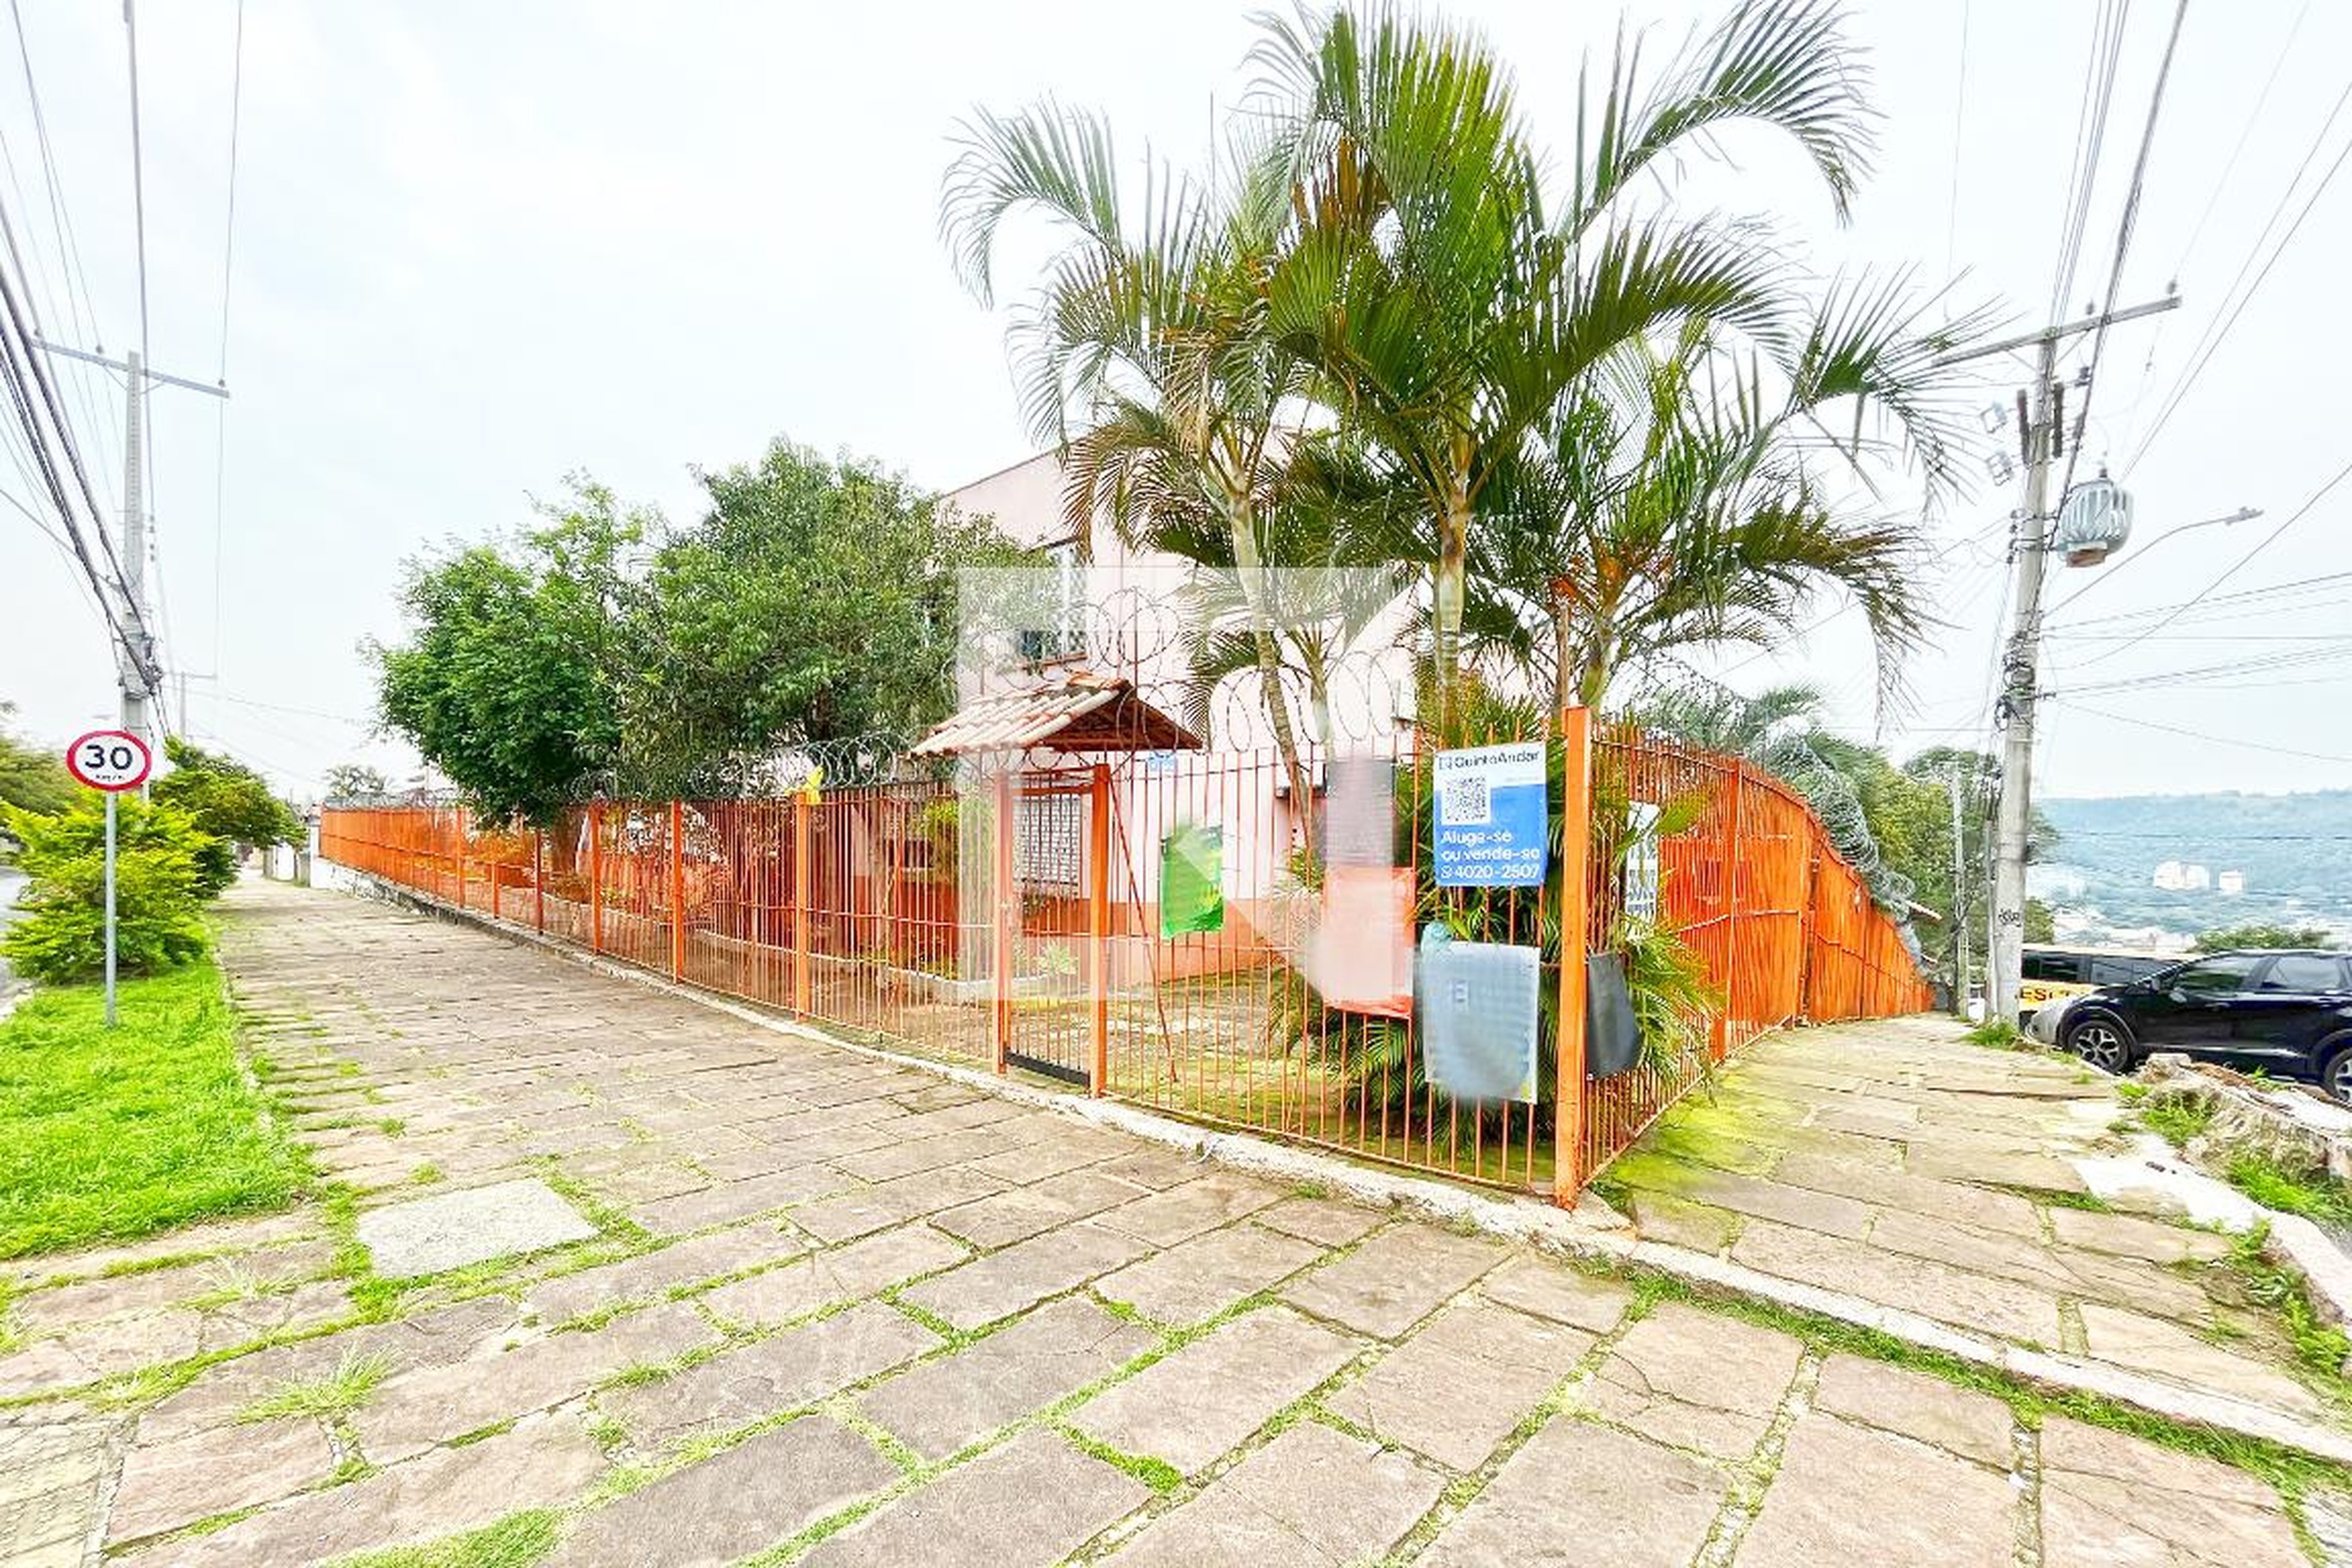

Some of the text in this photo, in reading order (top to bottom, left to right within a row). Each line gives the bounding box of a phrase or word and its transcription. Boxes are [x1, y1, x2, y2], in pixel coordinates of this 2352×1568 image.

[85, 745, 133, 770] 30
[1454, 751, 1539, 768] QuintoAndar
[1441, 846, 1540, 862] ou vende-se
[1455, 864, 1540, 879] 4020-2507
